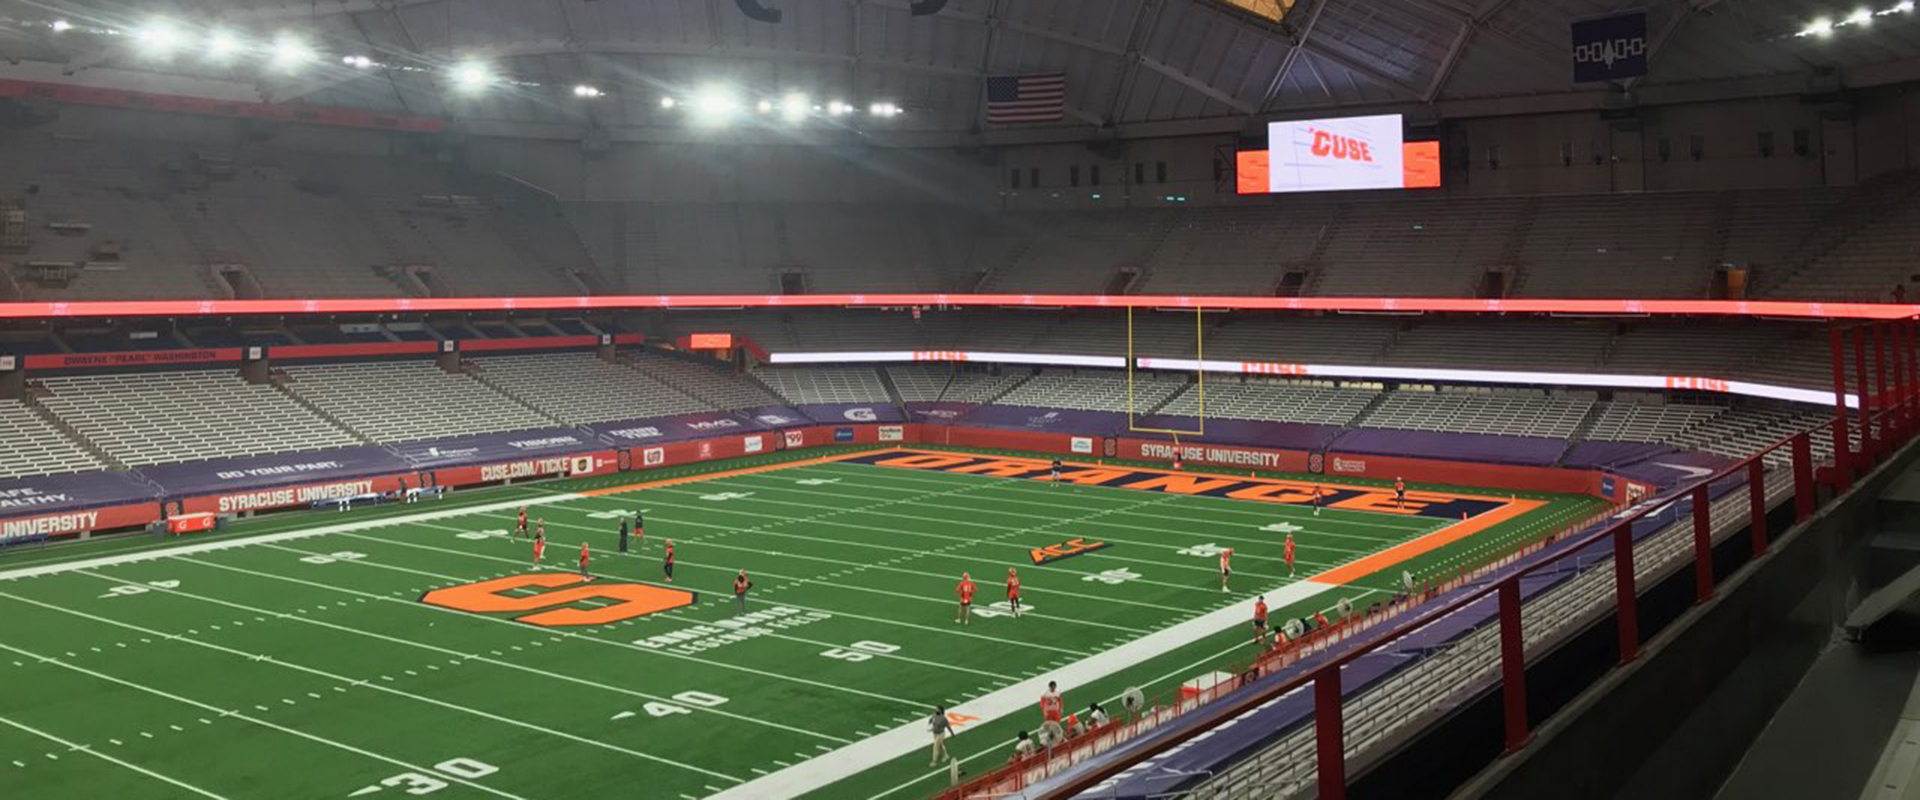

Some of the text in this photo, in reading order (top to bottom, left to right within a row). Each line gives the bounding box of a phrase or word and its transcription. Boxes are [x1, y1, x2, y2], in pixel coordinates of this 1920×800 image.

[63, 353, 107, 366] DWAYNE
[153, 350, 217, 362] WASHINGTON
[216, 460, 343, 480] DO YOUR PART.
[1206, 447, 1280, 468] UNIVERSITY
[219, 480, 373, 512] SYRACUSE UNIVERSITY
[874, 454, 1458, 514] ORANGE
[1030, 538, 1104, 563] ACC
[819, 639, 901, 662] 50
[642, 690, 730, 718] 40
[380, 757, 500, 796] 30
